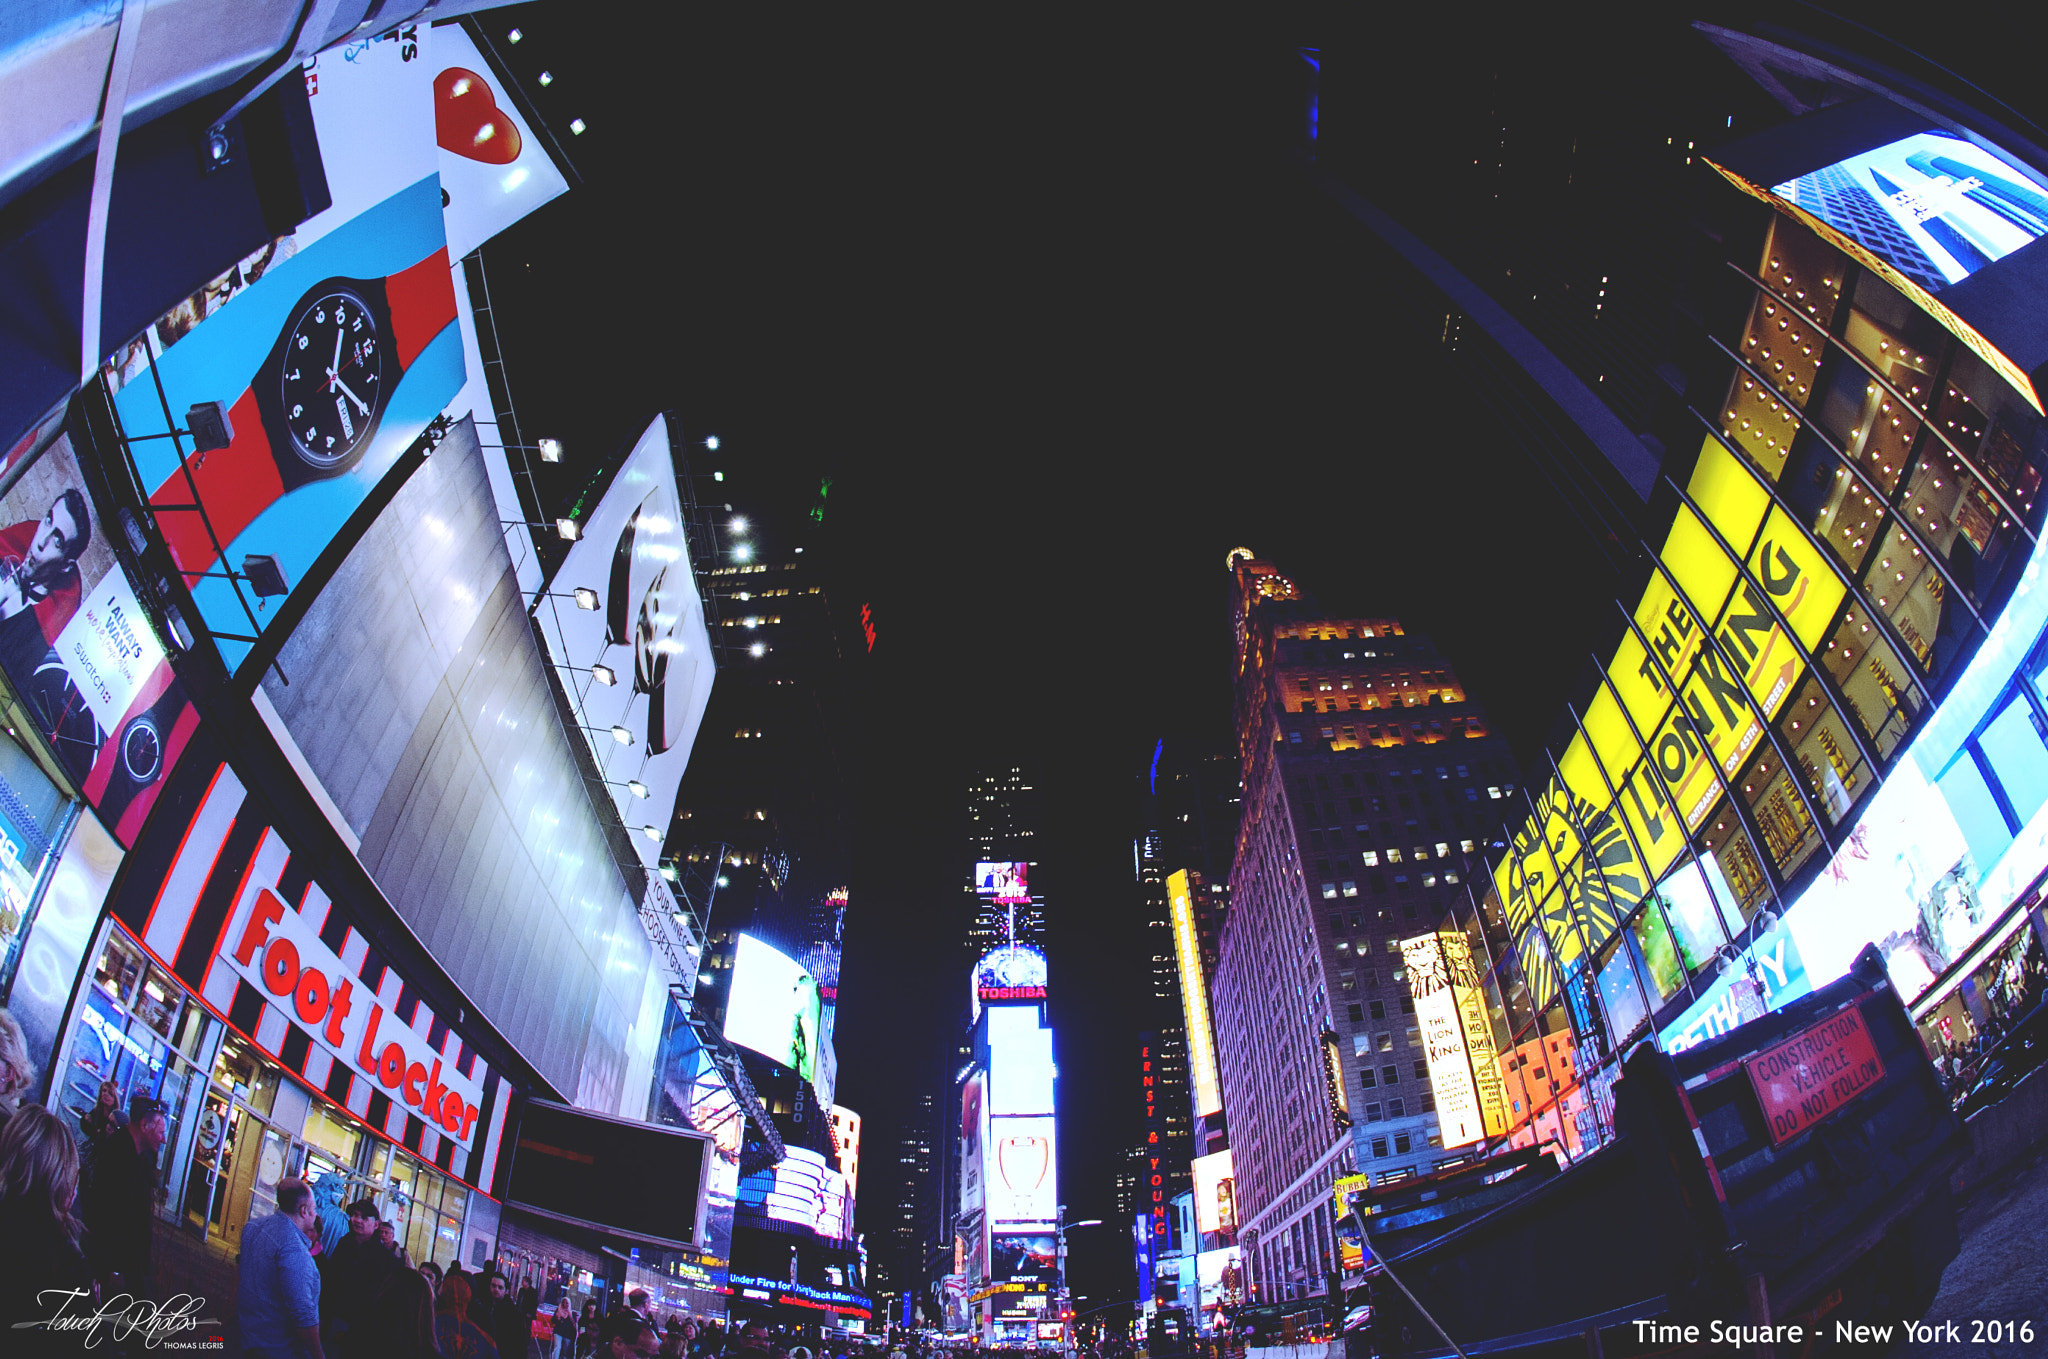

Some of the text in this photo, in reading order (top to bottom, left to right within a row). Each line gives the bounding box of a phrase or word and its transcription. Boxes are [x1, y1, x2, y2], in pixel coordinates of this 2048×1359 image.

[105, 616, 130, 659] WANT
[111, 606, 143, 659] ALWAYS
[1639, 598, 1694, 693] THE
[73, 642, 106, 695] swatch
[1621, 539, 1801, 845] LION KING
[1687, 677, 1788, 827] ENTRANCE ON 45TH STREET
[654, 876, 669, 917] YOUR
[991, 896, 1032, 904] TOSHIBA
[231, 886, 354, 1049] Foot
[354, 1000, 479, 1142] Locker
[979, 986, 1047, 999] TOSHIBA
[1427, 1028, 1453, 1044] LION
[1428, 1016, 1446, 1027] THE
[1429, 1043, 1461, 1063] KING
[1757, 1013, 1859, 1082] CONSTRUCTION
[1790, 1047, 1851, 1094] VEHICLE
[793, 1081, 804, 1122] 1500
[1775, 1057, 1879, 1137] DO NOT FOLLOW
[1142, 1047, 1166, 1235] ERNST & YOUNG
[1336, 1181, 1365, 1194] BUBBA
[729, 1274, 756, 1285] Under
[757, 1277, 776, 1289] Fire
[778, 1281, 792, 1291] for
